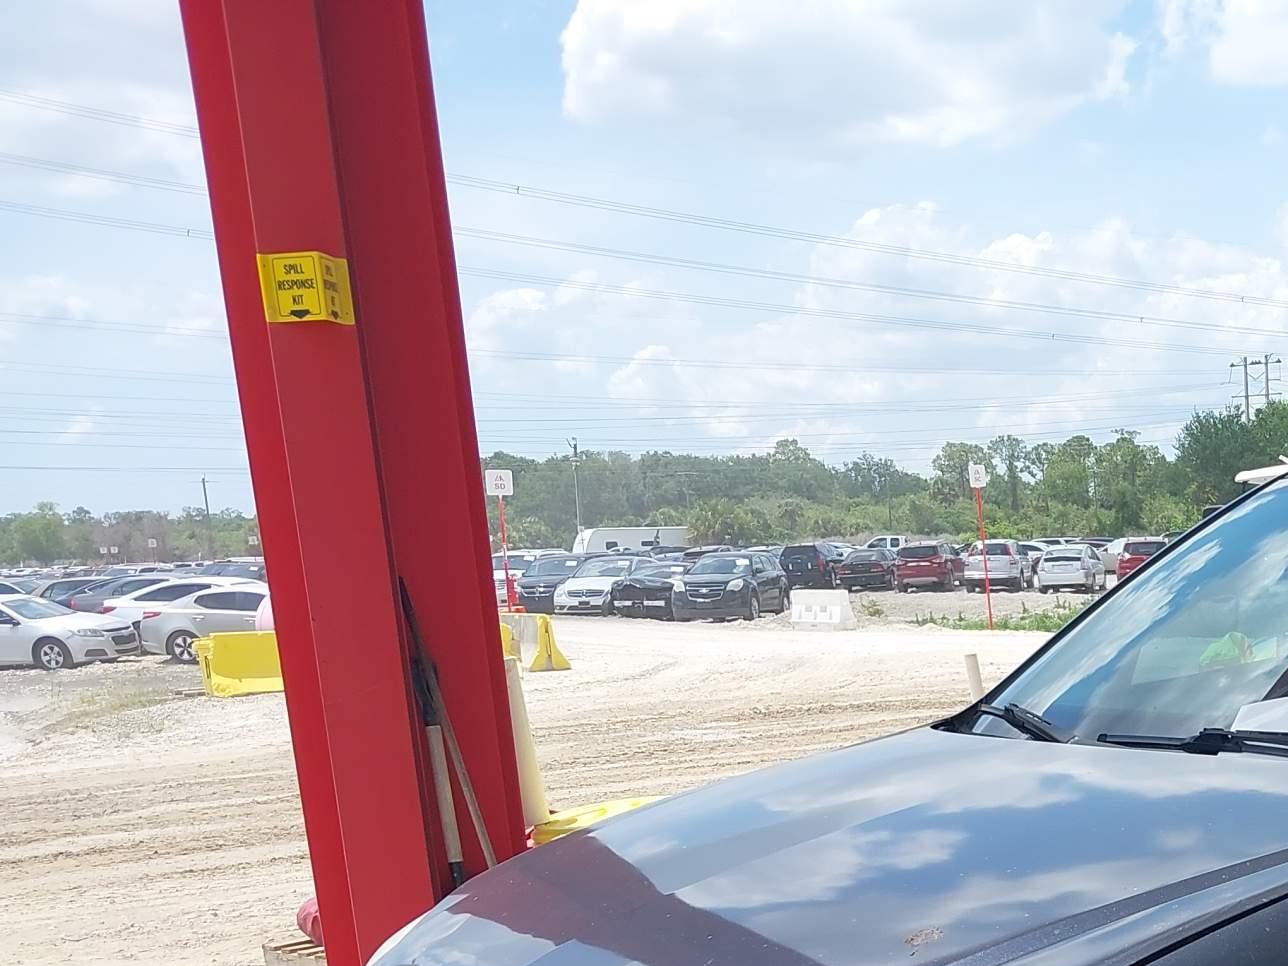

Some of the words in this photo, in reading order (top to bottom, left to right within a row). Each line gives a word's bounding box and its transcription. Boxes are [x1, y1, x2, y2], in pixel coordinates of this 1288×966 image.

[283, 263, 305, 275] SPILL
[277, 278, 316, 291] RESPONSE
[292, 294, 304, 306] KIT
